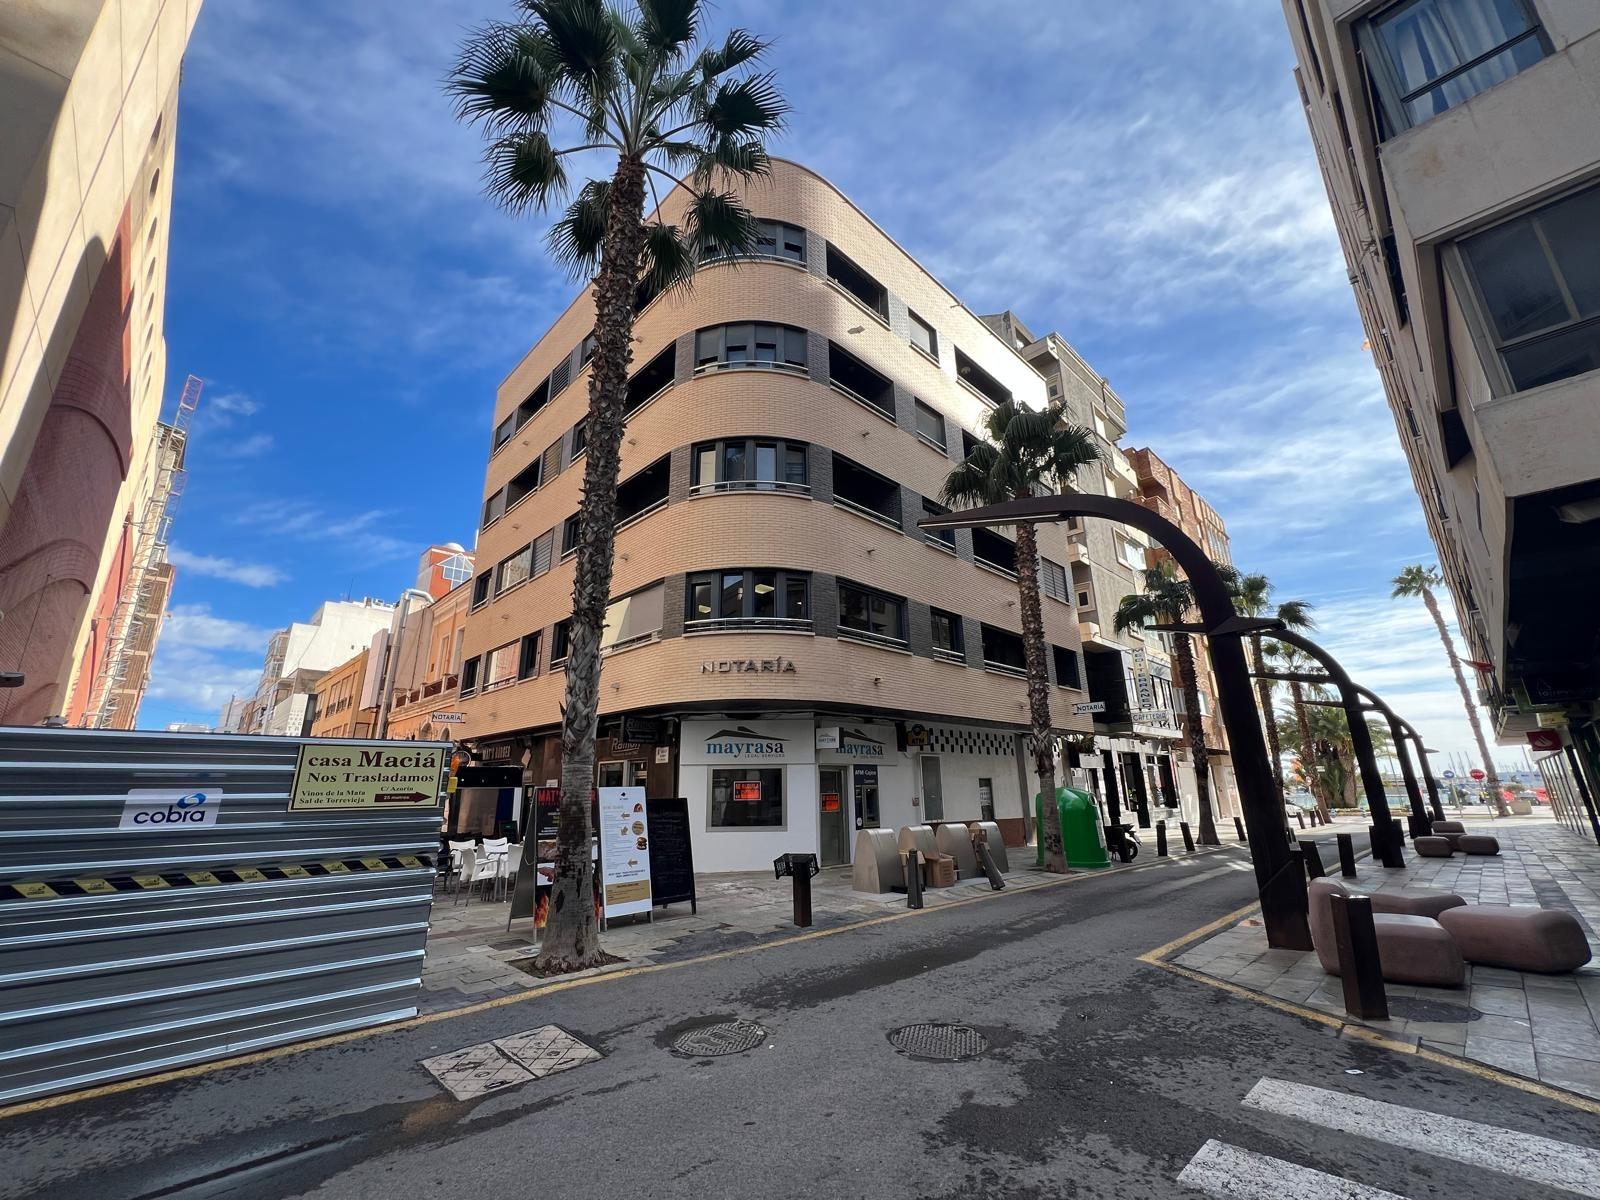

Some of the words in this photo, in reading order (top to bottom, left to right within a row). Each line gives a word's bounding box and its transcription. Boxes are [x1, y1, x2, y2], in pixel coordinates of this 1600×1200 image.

[701, 656, 797, 673] NOTARÍA
[706, 742, 785, 758] mayrasa
[308, 756, 352, 767] casa
[357, 750, 436, 768] Maciá
[306, 772, 337, 783] Nos
[342, 772, 435, 783] Trasladamos
[133, 805, 206, 825] cobra
